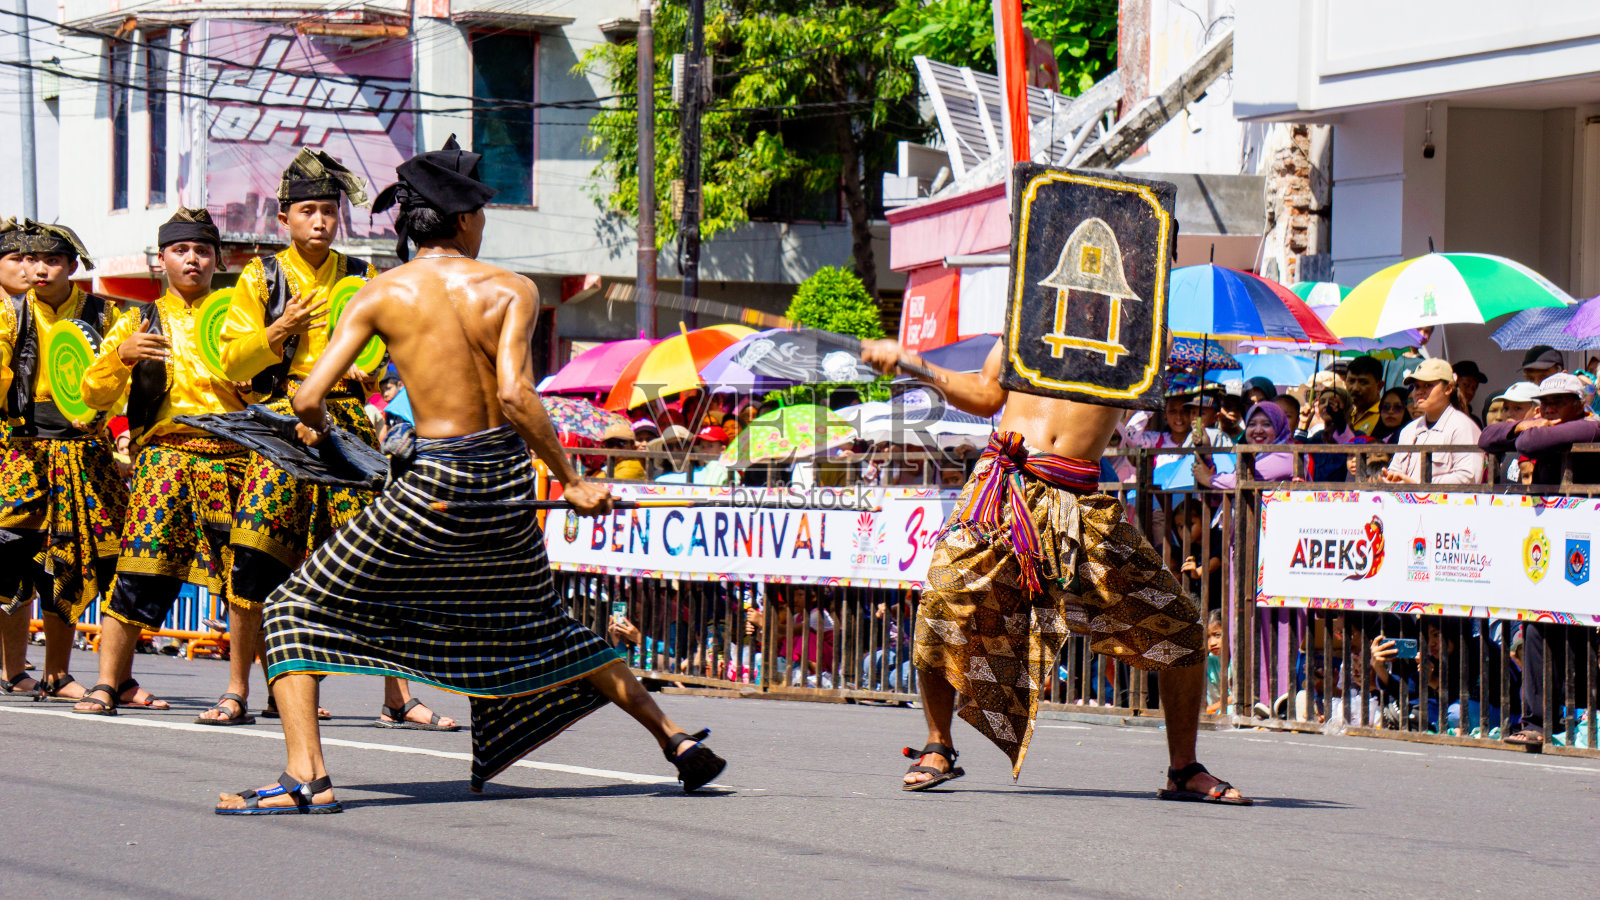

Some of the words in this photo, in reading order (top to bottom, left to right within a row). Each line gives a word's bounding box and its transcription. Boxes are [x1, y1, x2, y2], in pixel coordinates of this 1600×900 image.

[591, 508, 650, 554] BEN
[662, 510, 832, 560] CARNIVAL
[898, 506, 946, 572] 3rd
[1435, 532, 1460, 550] BEN
[850, 551, 890, 565] carnival
[1434, 552, 1480, 565] CARNIVAL
